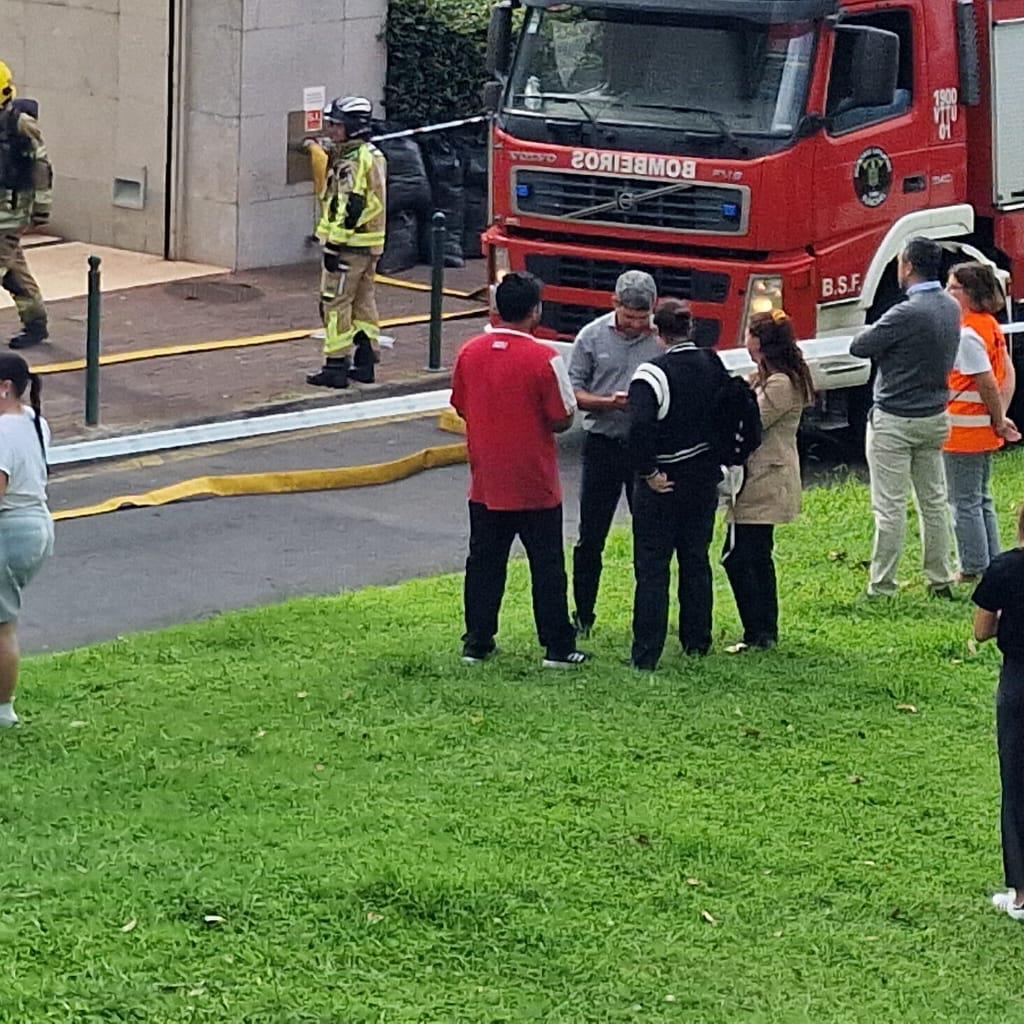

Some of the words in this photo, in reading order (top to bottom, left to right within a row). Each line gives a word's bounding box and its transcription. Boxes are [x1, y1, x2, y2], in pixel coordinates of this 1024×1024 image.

[933, 87, 958, 106] 1900
[933, 105, 958, 124] VTTU
[939, 124, 951, 140] 01
[822, 273, 861, 297] B.S.F.
